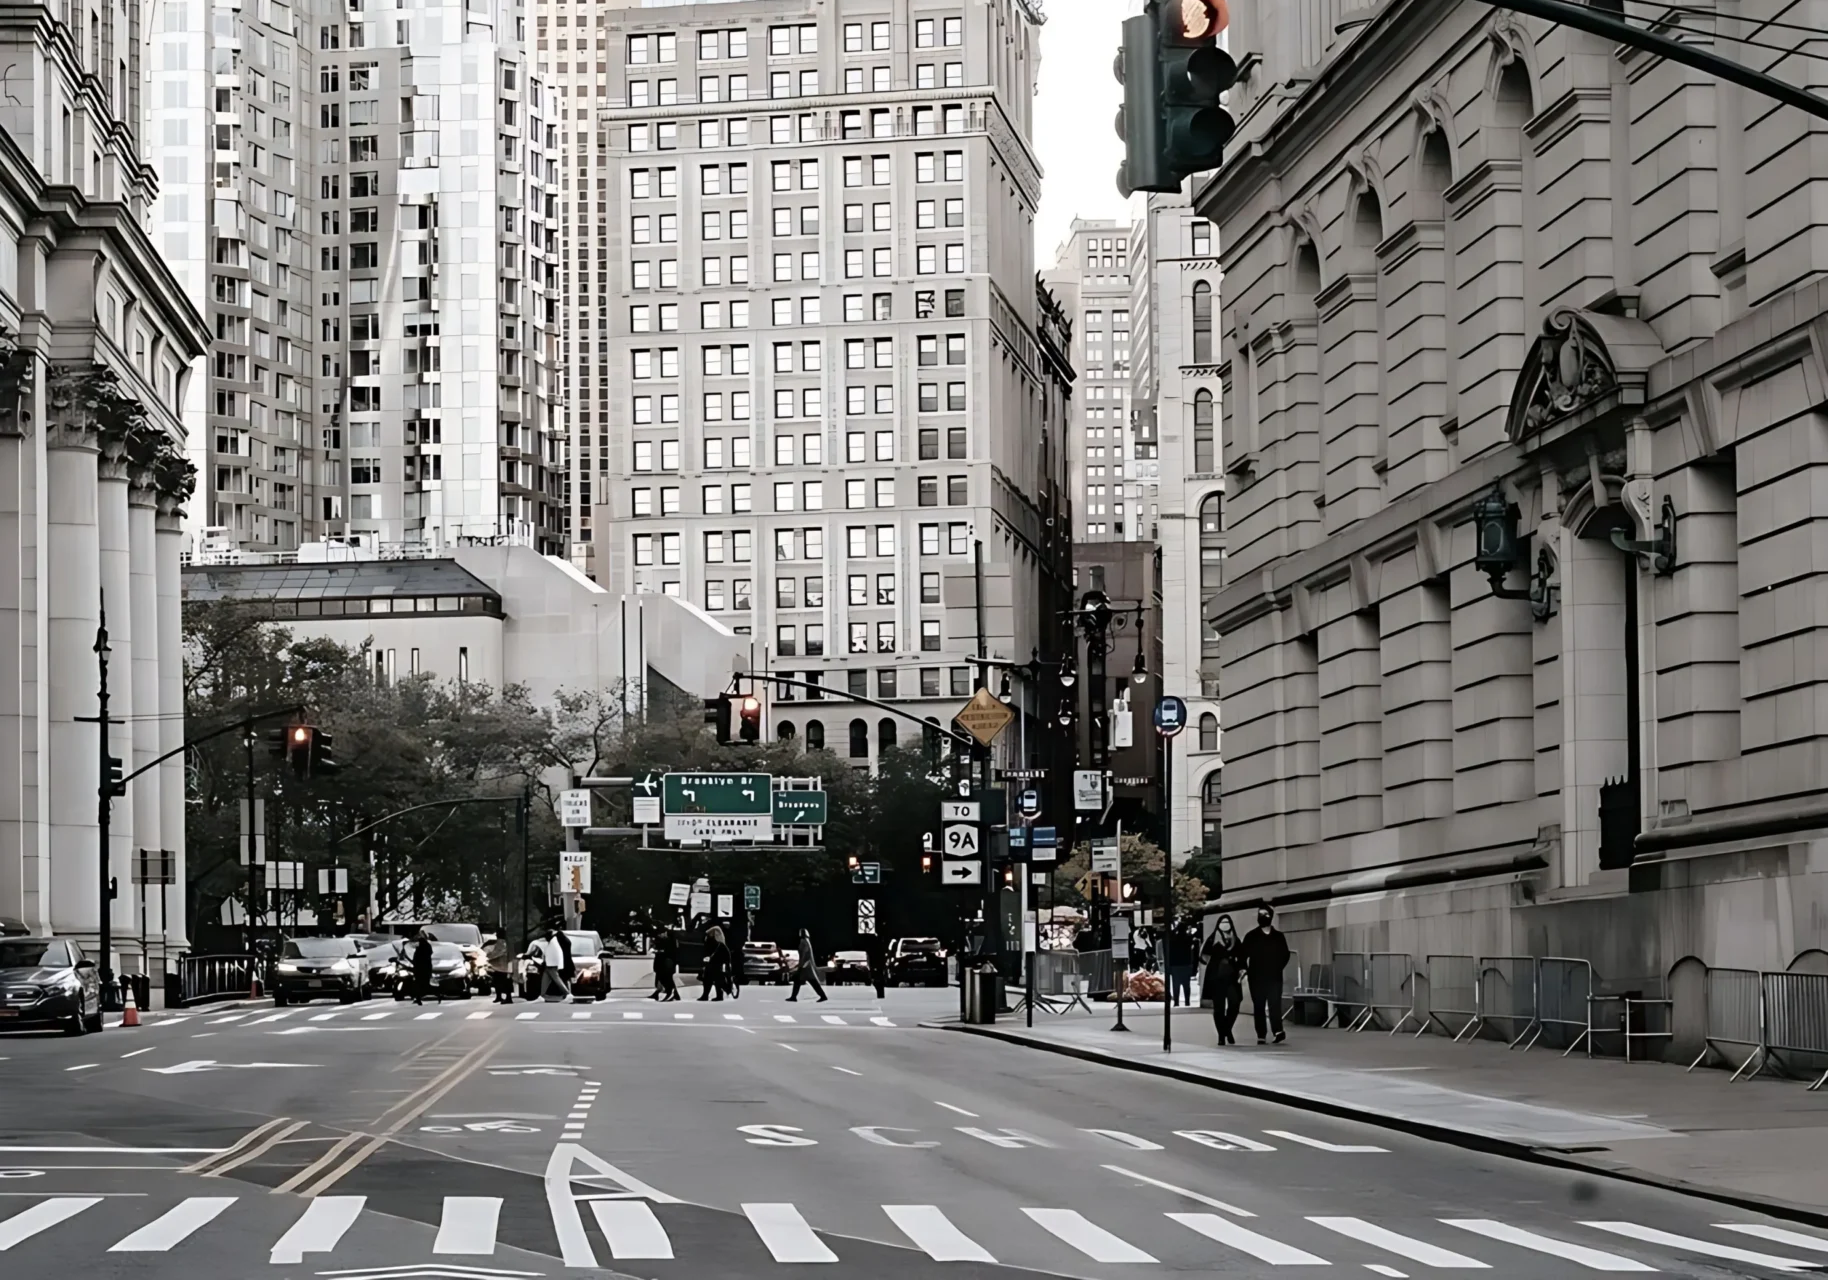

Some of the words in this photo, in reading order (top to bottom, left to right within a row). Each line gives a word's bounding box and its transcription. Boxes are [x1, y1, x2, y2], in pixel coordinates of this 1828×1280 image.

[952, 805, 970, 817] TO
[948, 831, 976, 850] 9A
[736, 1123, 1392, 1153] SCHOOL
